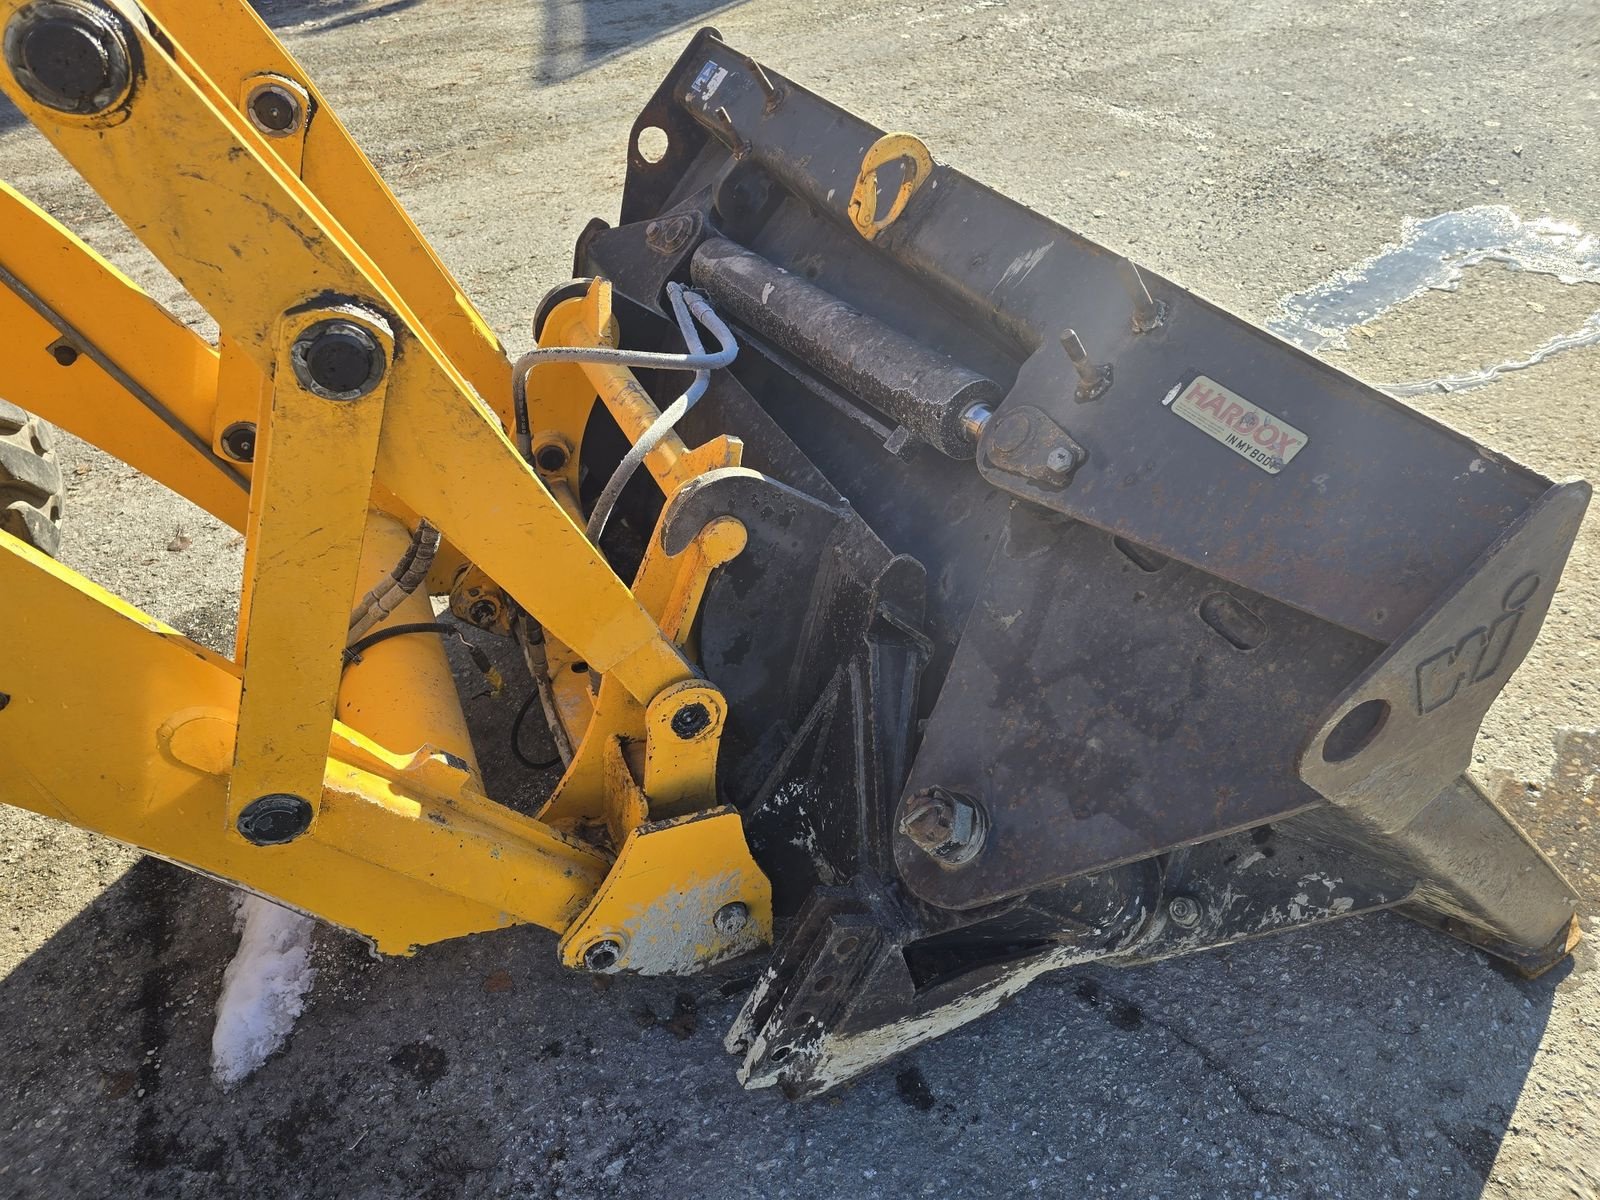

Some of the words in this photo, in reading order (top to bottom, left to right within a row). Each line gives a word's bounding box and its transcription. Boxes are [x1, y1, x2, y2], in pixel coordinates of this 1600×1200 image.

[1185, 382, 1296, 457] HARDOX
[1225, 433, 1238, 445] IN
[1235, 439, 1253, 453] MY
